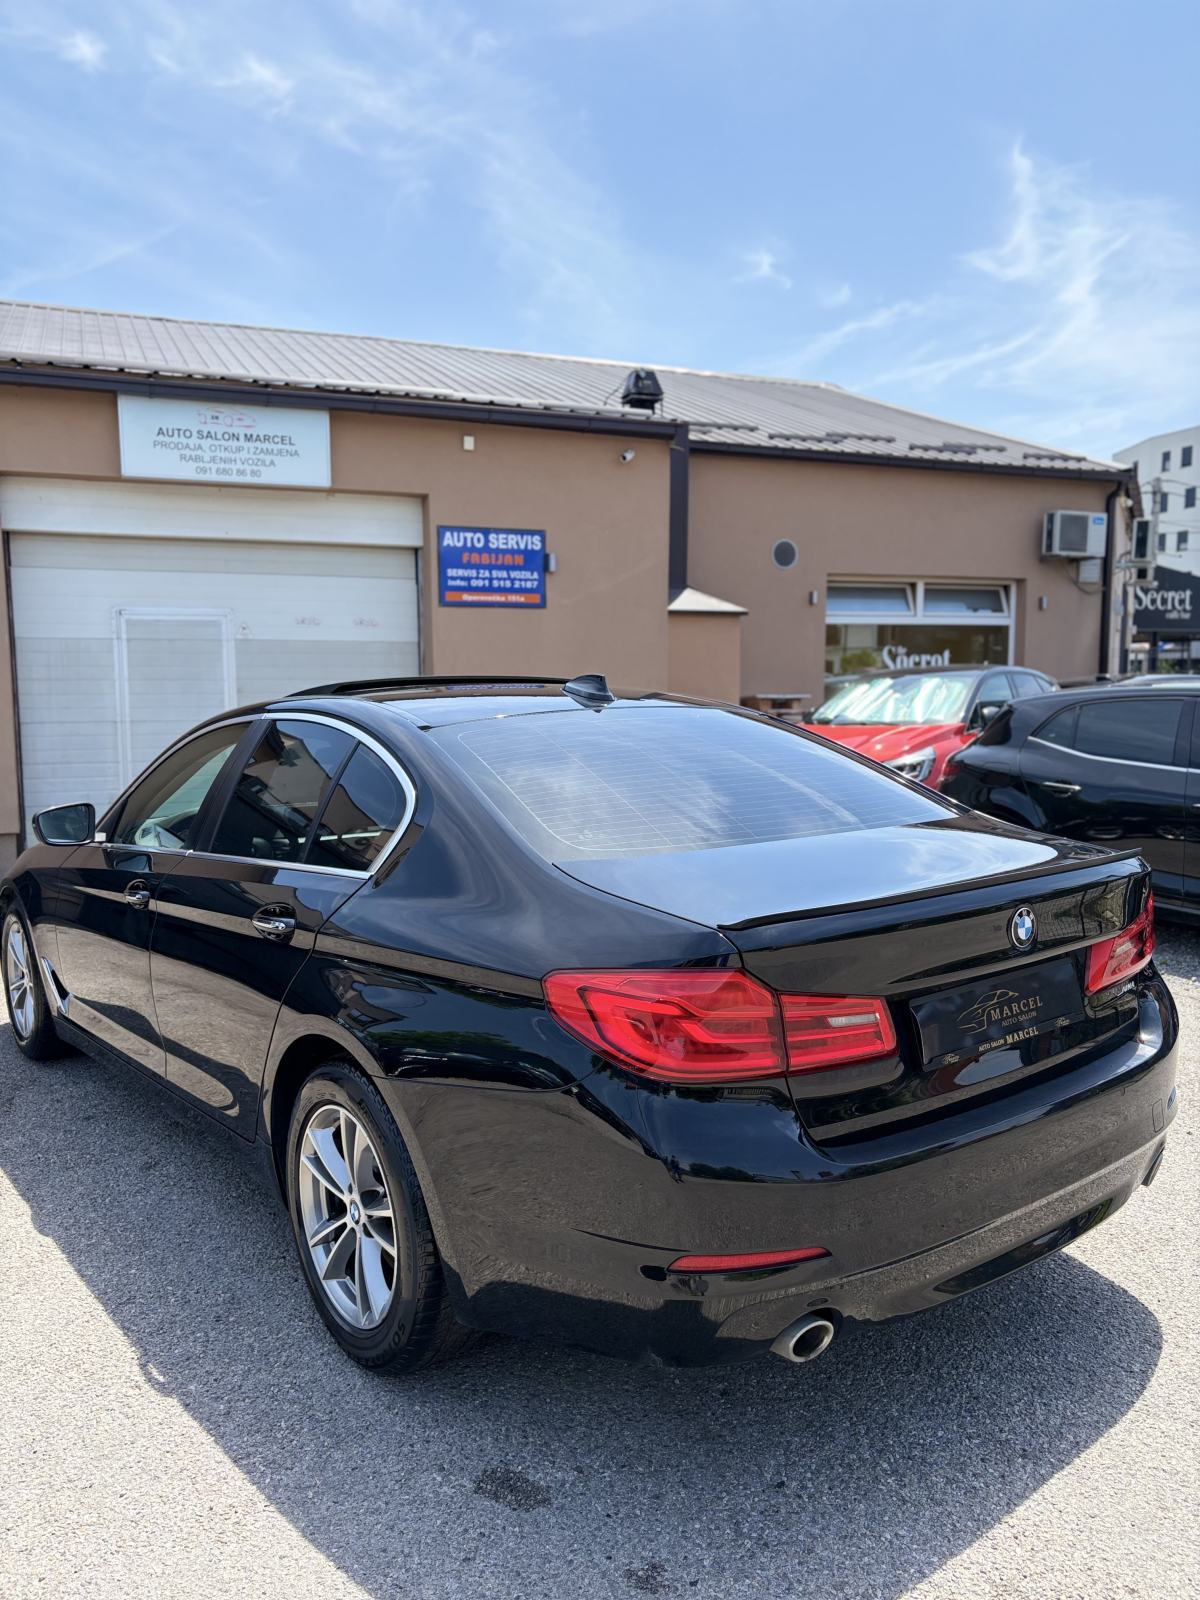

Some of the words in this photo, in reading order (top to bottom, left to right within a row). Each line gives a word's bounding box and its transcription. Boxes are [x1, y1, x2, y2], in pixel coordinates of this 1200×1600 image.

[156, 426, 193, 440] AUTO
[196, 429, 241, 443] SALON
[244, 432, 296, 446] MARCEL
[153, 440, 206, 453] PRODAJA,
[209, 443, 245, 455] OTKUP
[252, 446, 300, 458] ZAMJENA
[179, 452, 237, 466] RABLJENIH
[239, 457, 276, 468] VOZILA
[195, 466, 213, 476] 091
[216, 466, 233, 477] 680
[235, 468, 248, 477] 86
[249, 469, 262, 478] 80
[443, 531, 485, 548] AUTO
[488, 533, 542, 551] SERVIS
[462, 552, 525, 565] FABIJAN
[446, 568, 477, 578] SERVIS
[478, 569, 490, 578] ZA
[491, 570, 508, 579] SVA
[509, 571, 539, 580] VOZILA
[470, 579, 489, 588] 091
[491, 580, 511, 589] 515
[513, 580, 539, 589] 2187
[1135, 585, 1192, 611] Secret
[990, 996, 1044, 1022] MARCEL
[1001, 1017, 1018, 1028] AUTO
[1018, 1010, 1037, 1022] SALON
[978, 1043, 991, 1052] AUTO
[990, 1038, 1004, 1049] SALON
[1005, 1026, 1039, 1045] MARCEL
